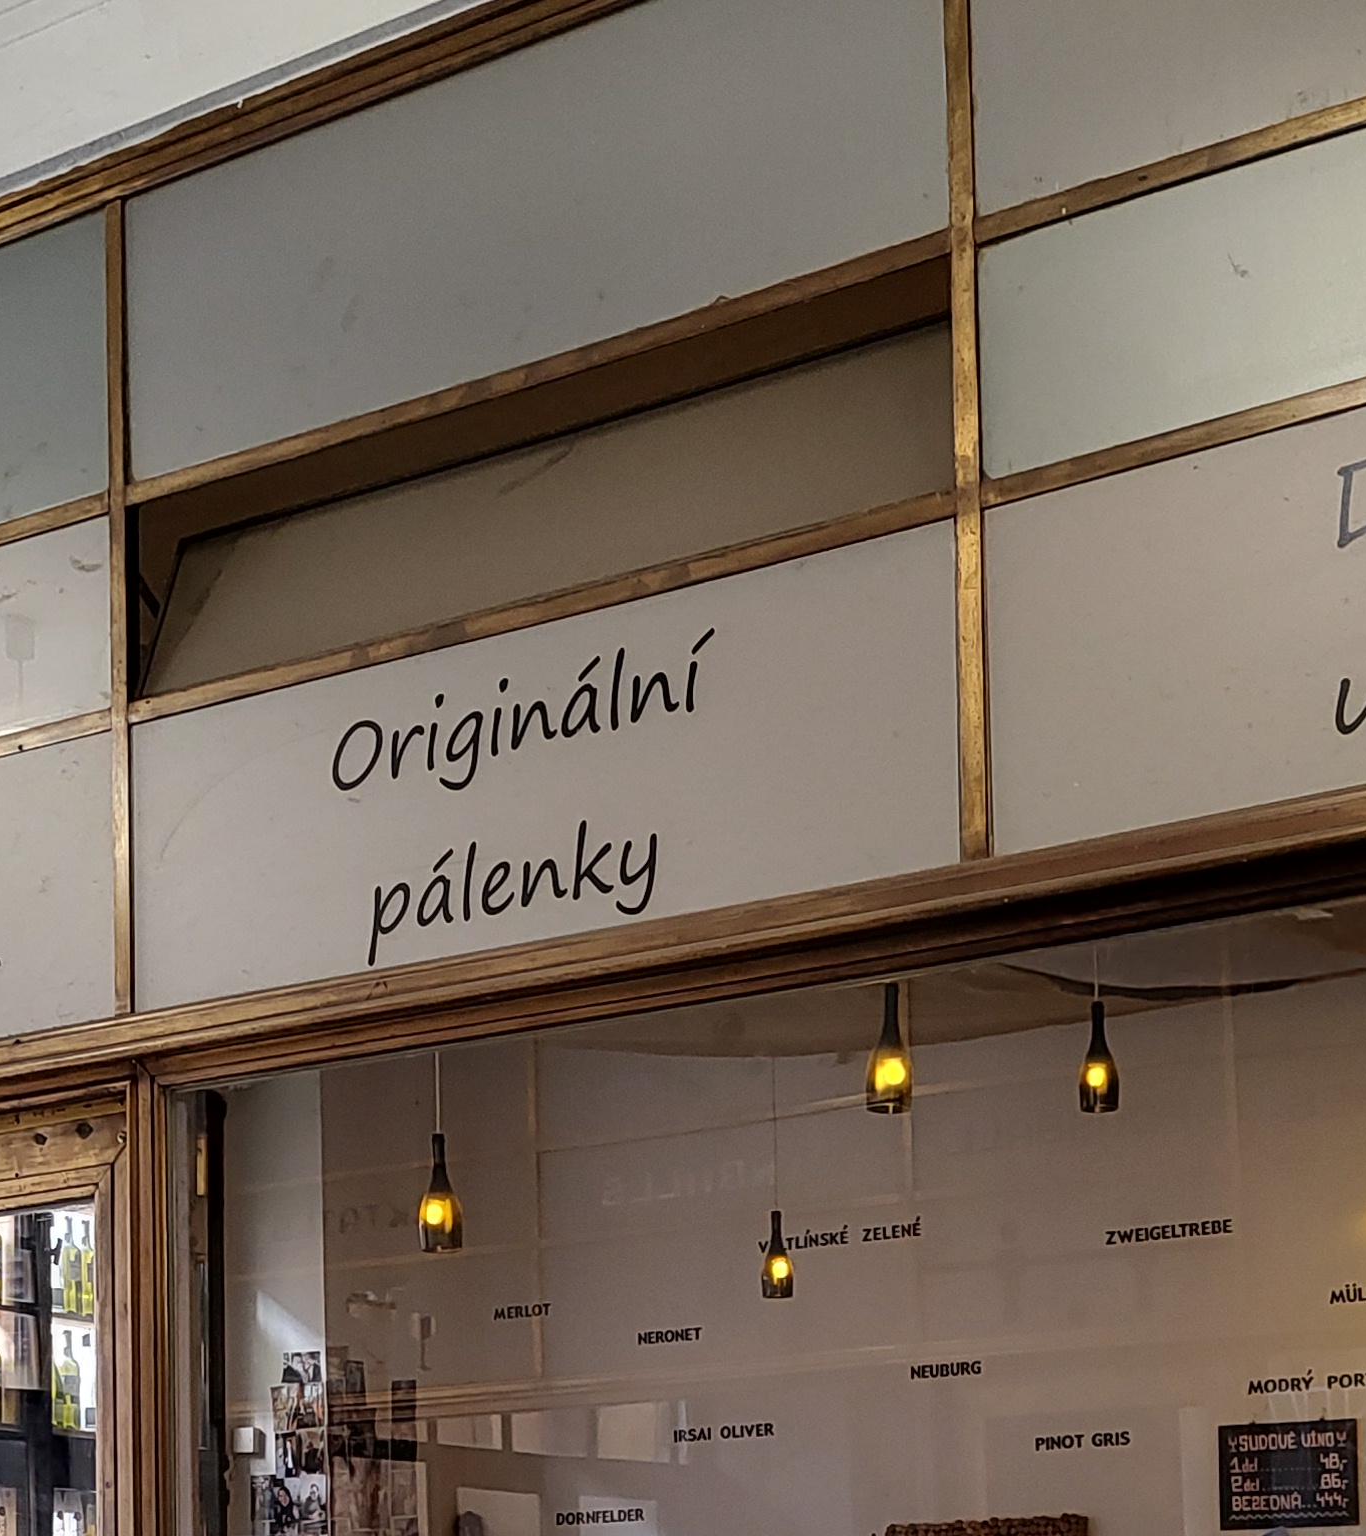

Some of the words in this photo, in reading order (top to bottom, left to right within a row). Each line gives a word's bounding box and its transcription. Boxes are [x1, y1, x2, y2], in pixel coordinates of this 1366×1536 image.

[329, 626, 716, 791] Originální
[366, 820, 659, 964] pálenky
[758, 1224, 849, 1254] VTLÍNSKÉ
[862, 1215, 921, 1242] ZELENÉ
[1105, 1218, 1233, 1246] ZWEIGELTREBE
[493, 1302, 551, 1321] MERLOT
[637, 1327, 702, 1346] NERONET
[910, 1360, 982, 1380] NEUBURG
[1247, 1369, 1315, 1395] MODRÝ
[673, 1427, 712, 1444] IRSAI
[720, 1422, 775, 1440] OLIVER
[1035, 1434, 1085, 1452] PINOT
[1091, 1430, 1131, 1448] GRIS
[1238, 1431, 1297, 1452] SUDOVÉ
[1301, 1429, 1334, 1448] VÍNO
[555, 1508, 645, 1526] DORNFELDER
